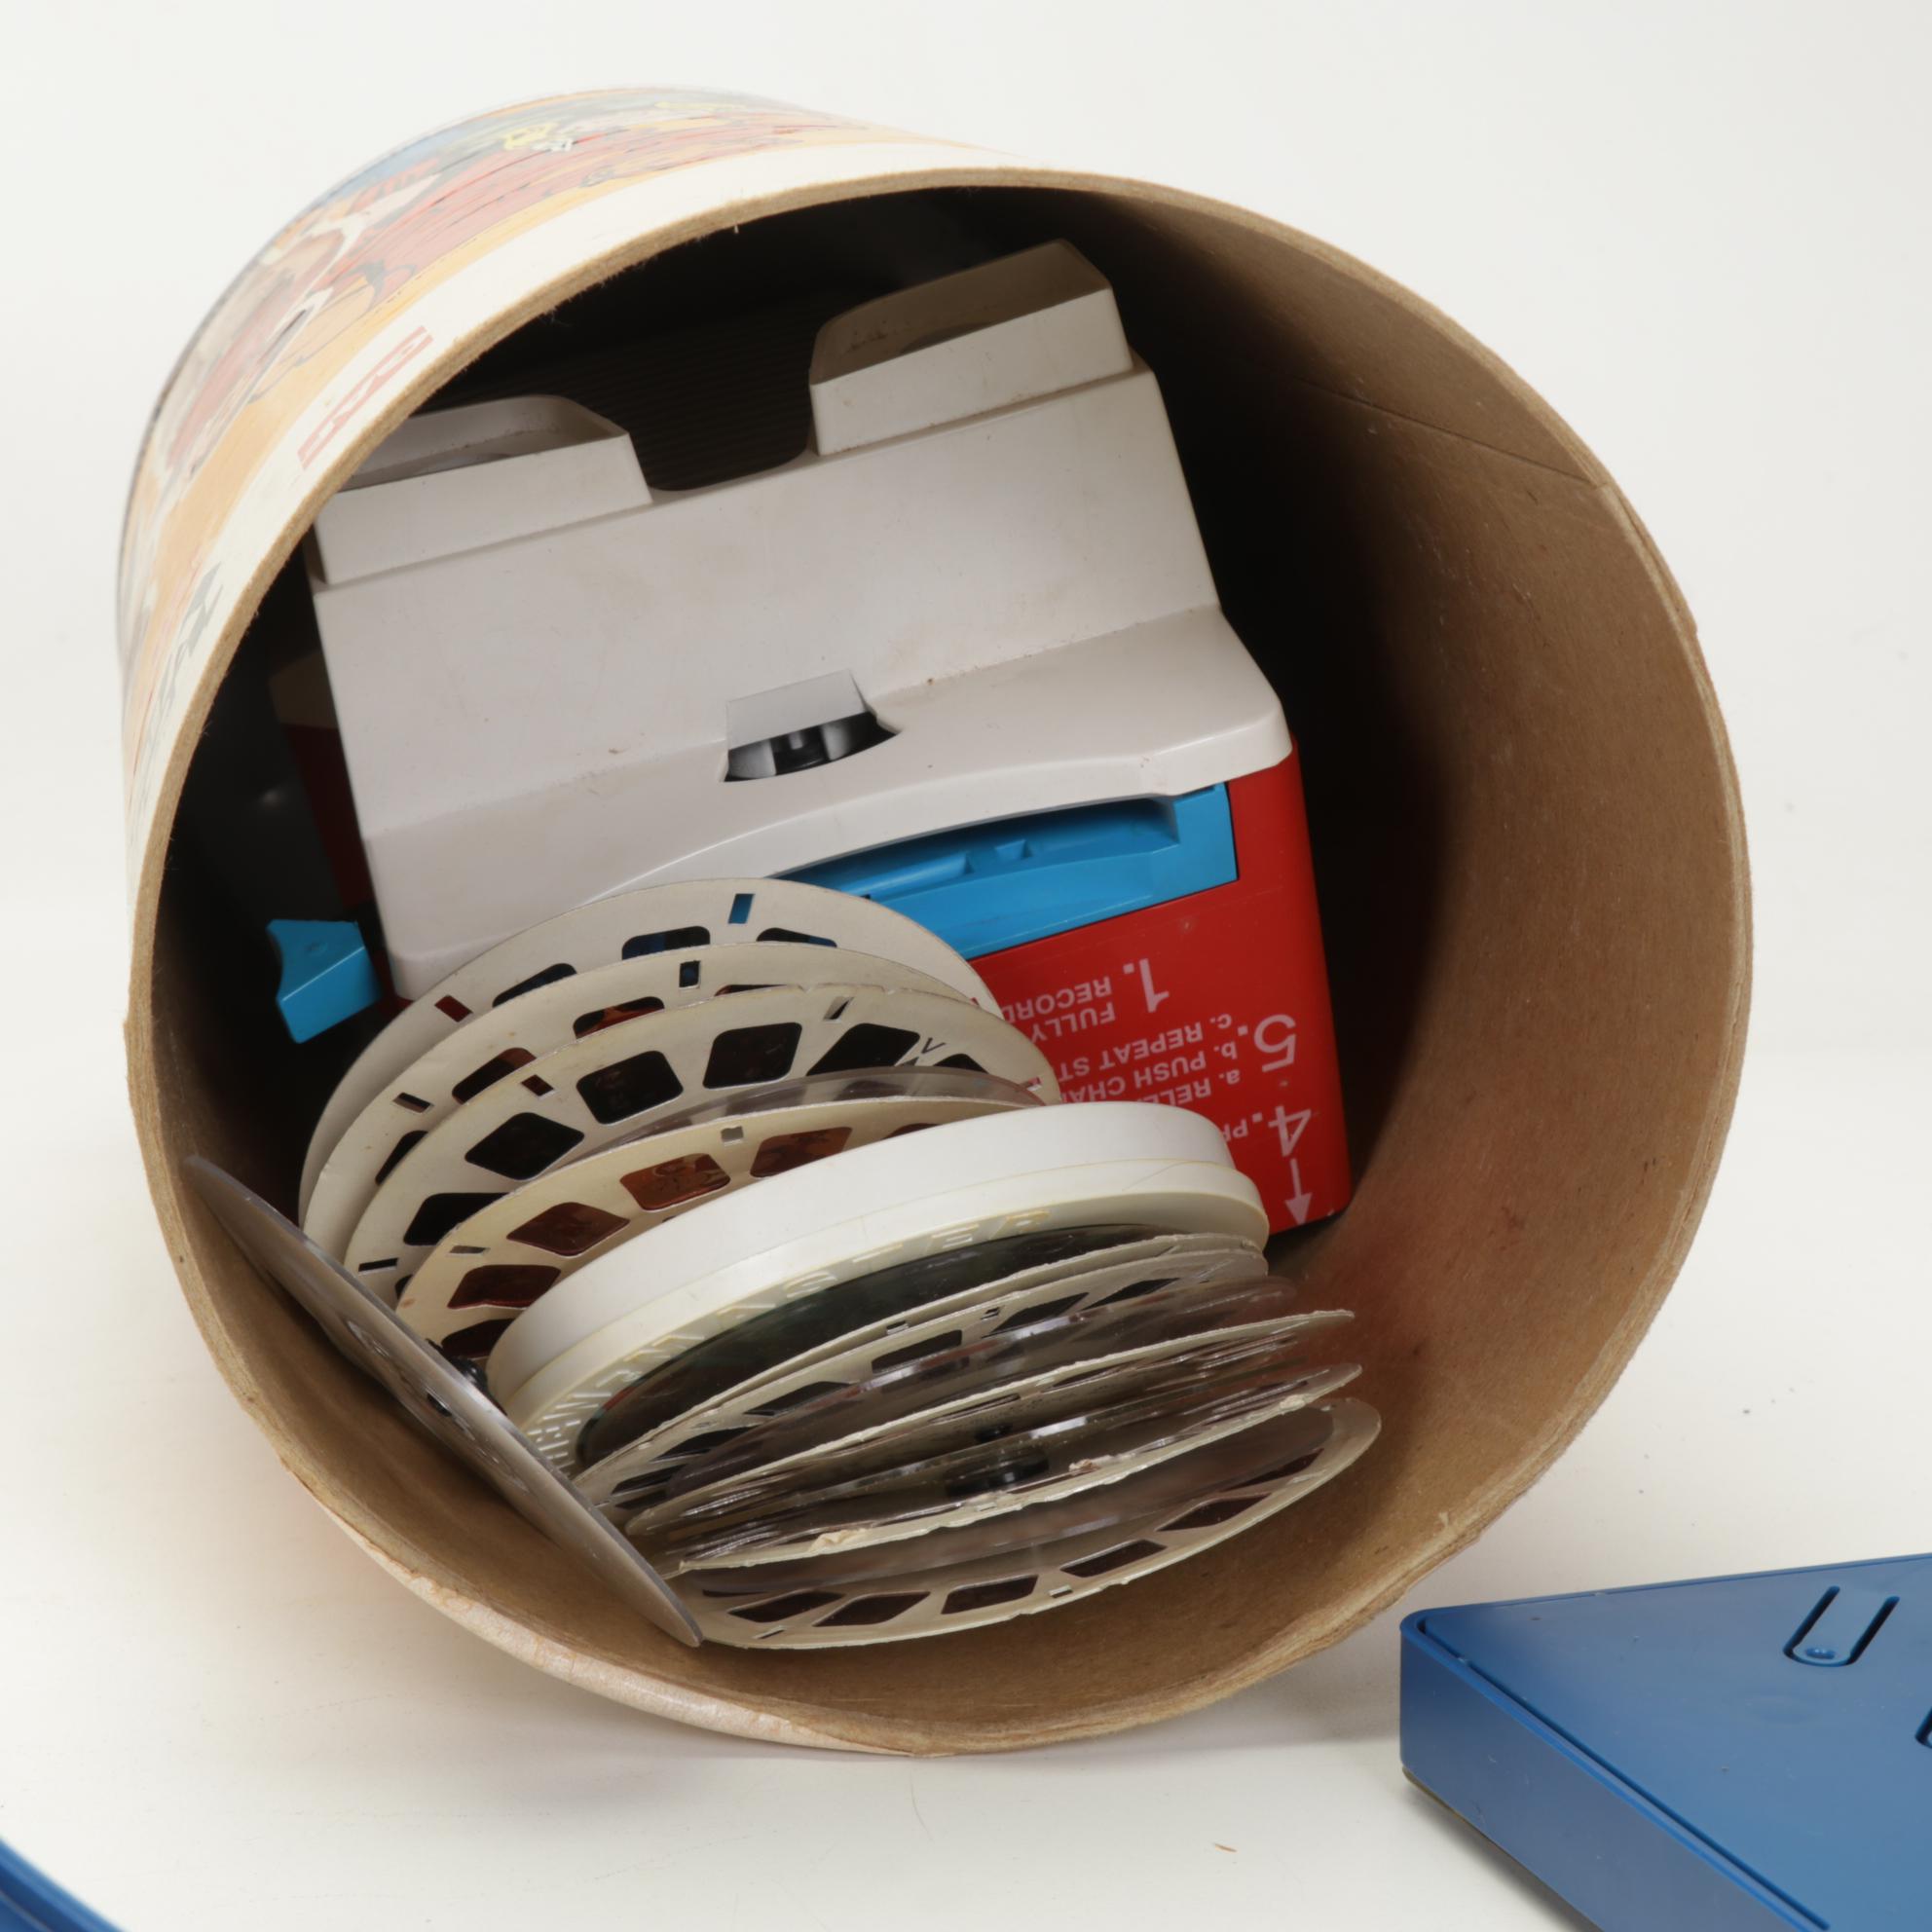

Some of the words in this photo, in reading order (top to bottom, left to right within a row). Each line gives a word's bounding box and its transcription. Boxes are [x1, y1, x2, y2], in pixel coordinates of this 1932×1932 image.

[1123, 958, 1169, 1013] 1.
[1031, 1002, 1115, 1043] FULLY
[1209, 1013, 1232, 1028] c.
[1099, 1022, 1204, 1070] REPEAT
[1213, 1041, 1238, 1059] b.
[1238, 1014, 1296, 1072] 5.
[1133, 1051, 1207, 1089] PUSH
[1218, 1069, 1241, 1085] a.
[1252, 1105, 1312, 1157] 4.
